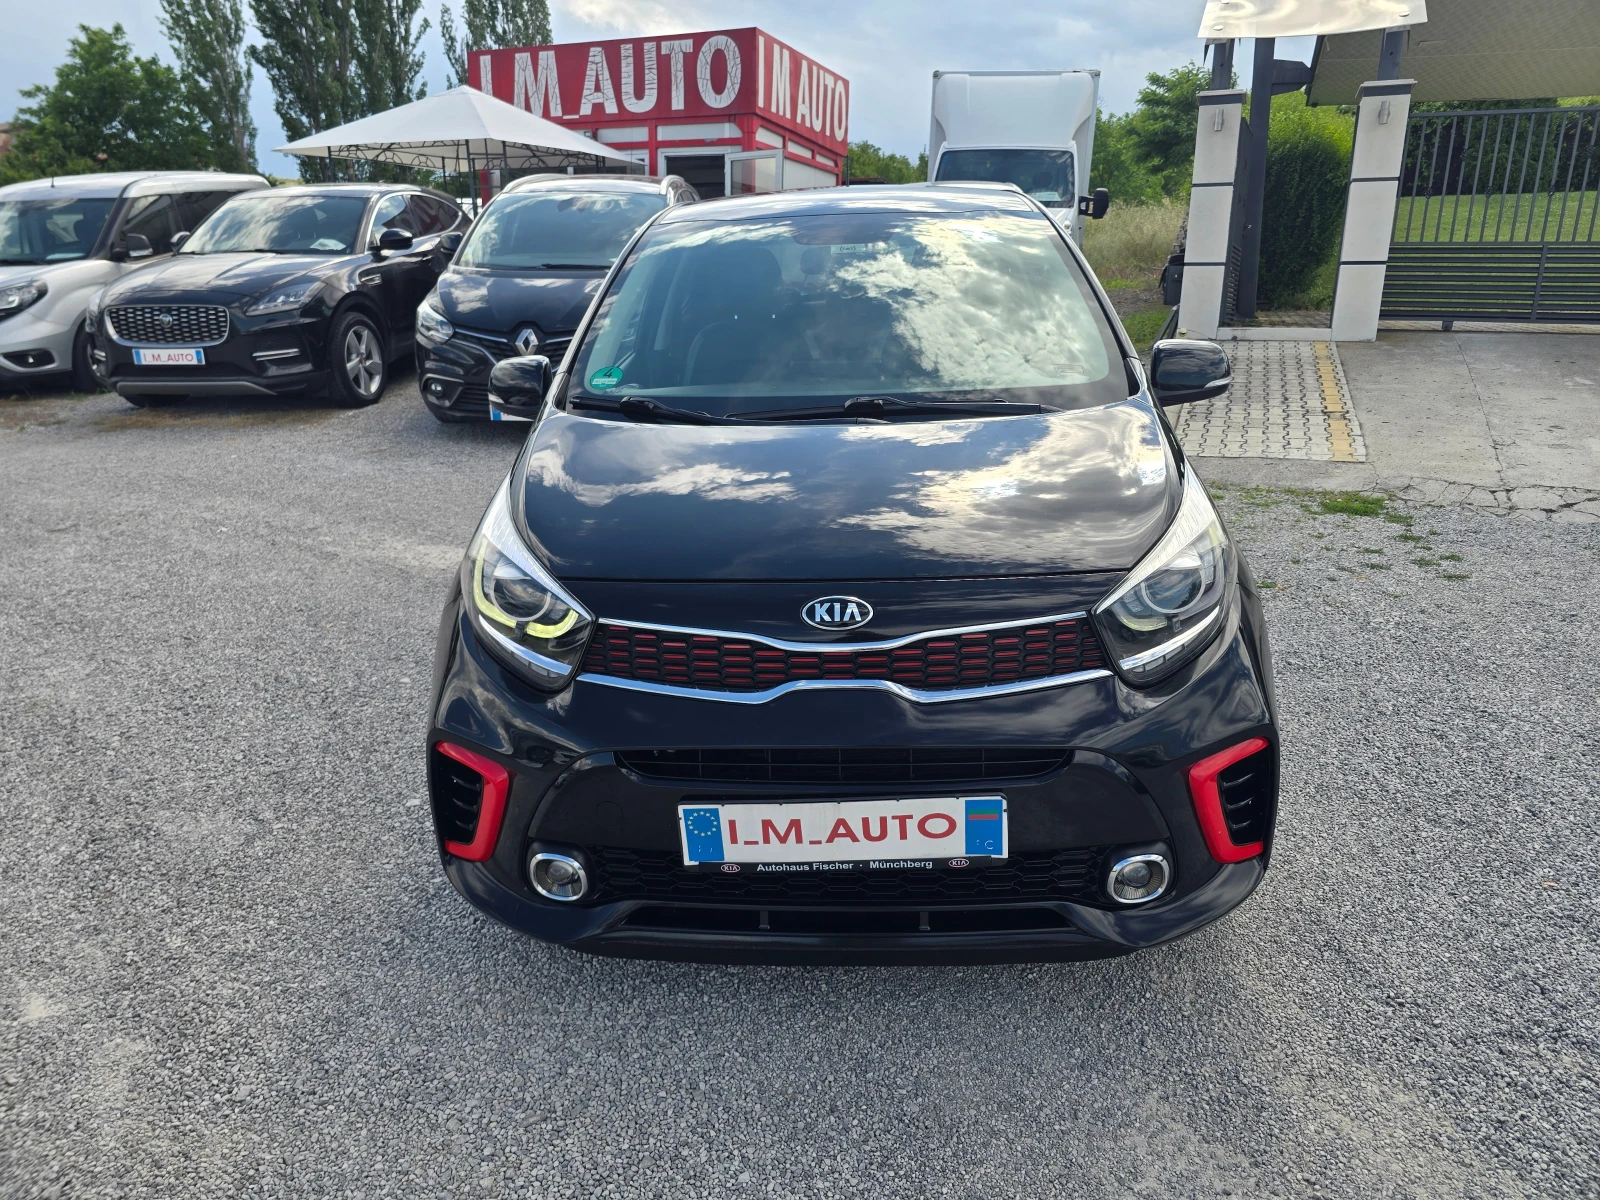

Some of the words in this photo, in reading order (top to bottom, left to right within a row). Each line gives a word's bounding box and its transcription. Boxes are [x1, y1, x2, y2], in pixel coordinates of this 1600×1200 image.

[758, 35, 764, 108] I
[771, 43, 791, 119] M
[796, 59, 846, 142] AUTO
[603, 367, 613, 378] 4
[814, 602, 862, 622] KIA
[757, 863, 809, 872] Autohaus
[813, 862, 854, 871] Fischer
[869, 860, 933, 869] Münchberg
